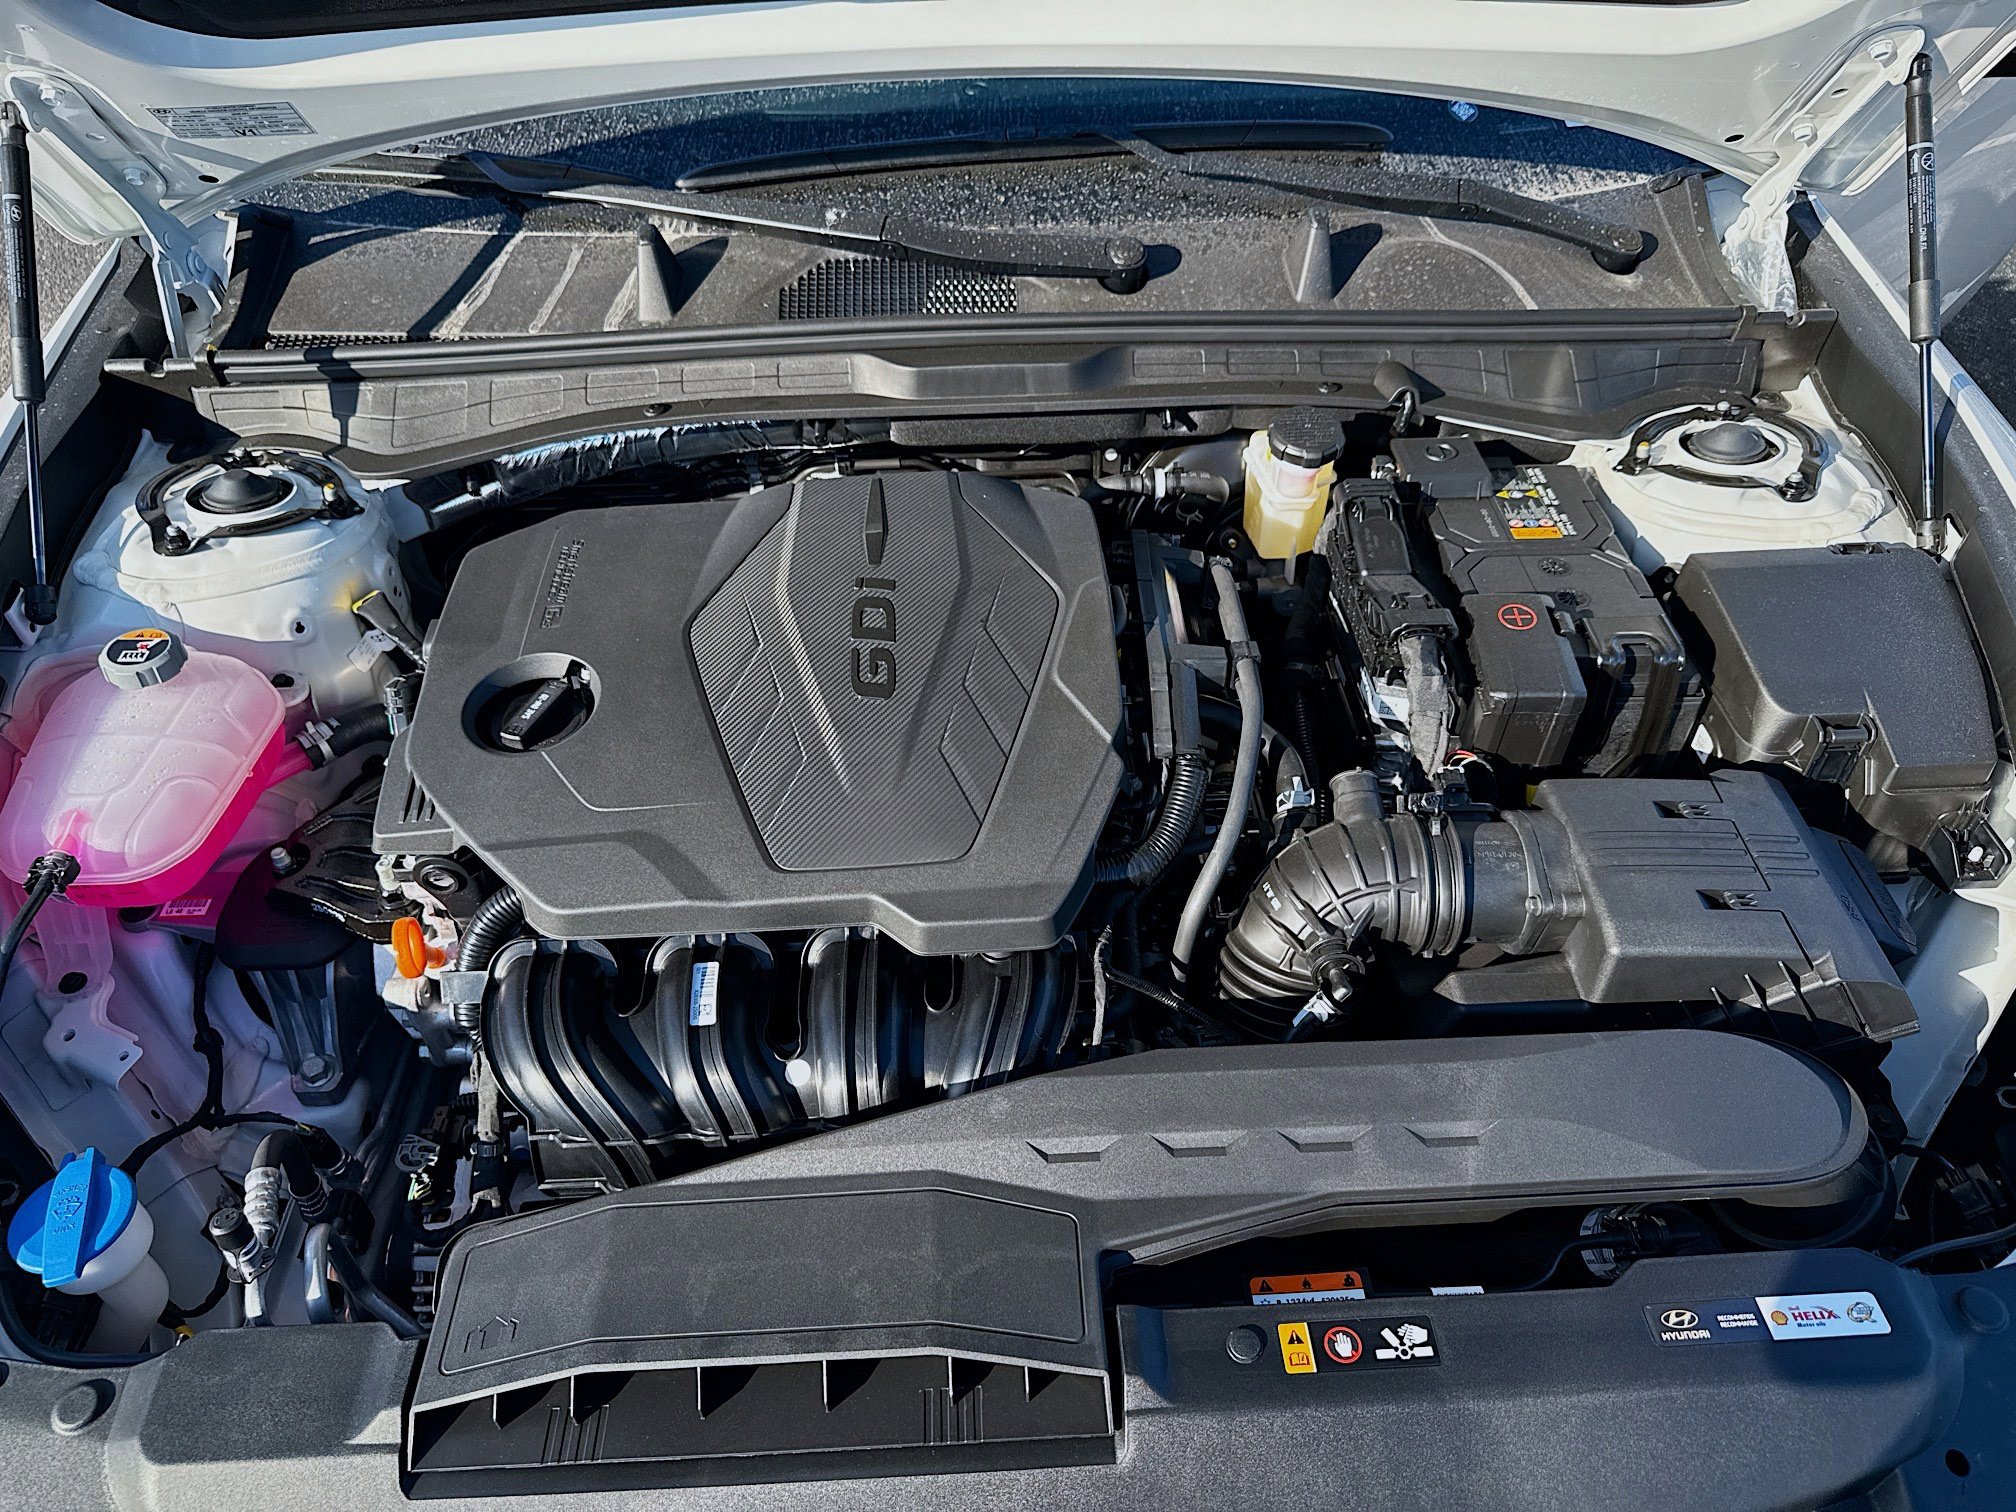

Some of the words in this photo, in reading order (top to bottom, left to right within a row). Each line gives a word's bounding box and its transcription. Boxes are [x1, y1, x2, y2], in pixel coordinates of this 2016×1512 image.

[235, 128, 258, 137] V1
[557, 538, 586, 604] Smartstream
[850, 577, 896, 700] GDi
[521, 708, 536, 720] SAE
[53, 1184, 88, 1199] WASHER
[53, 1222, 76, 1235] ONLY
[1791, 1310, 1838, 1321] HELIX
[1661, 1329, 1711, 1341] HYUNDAI
